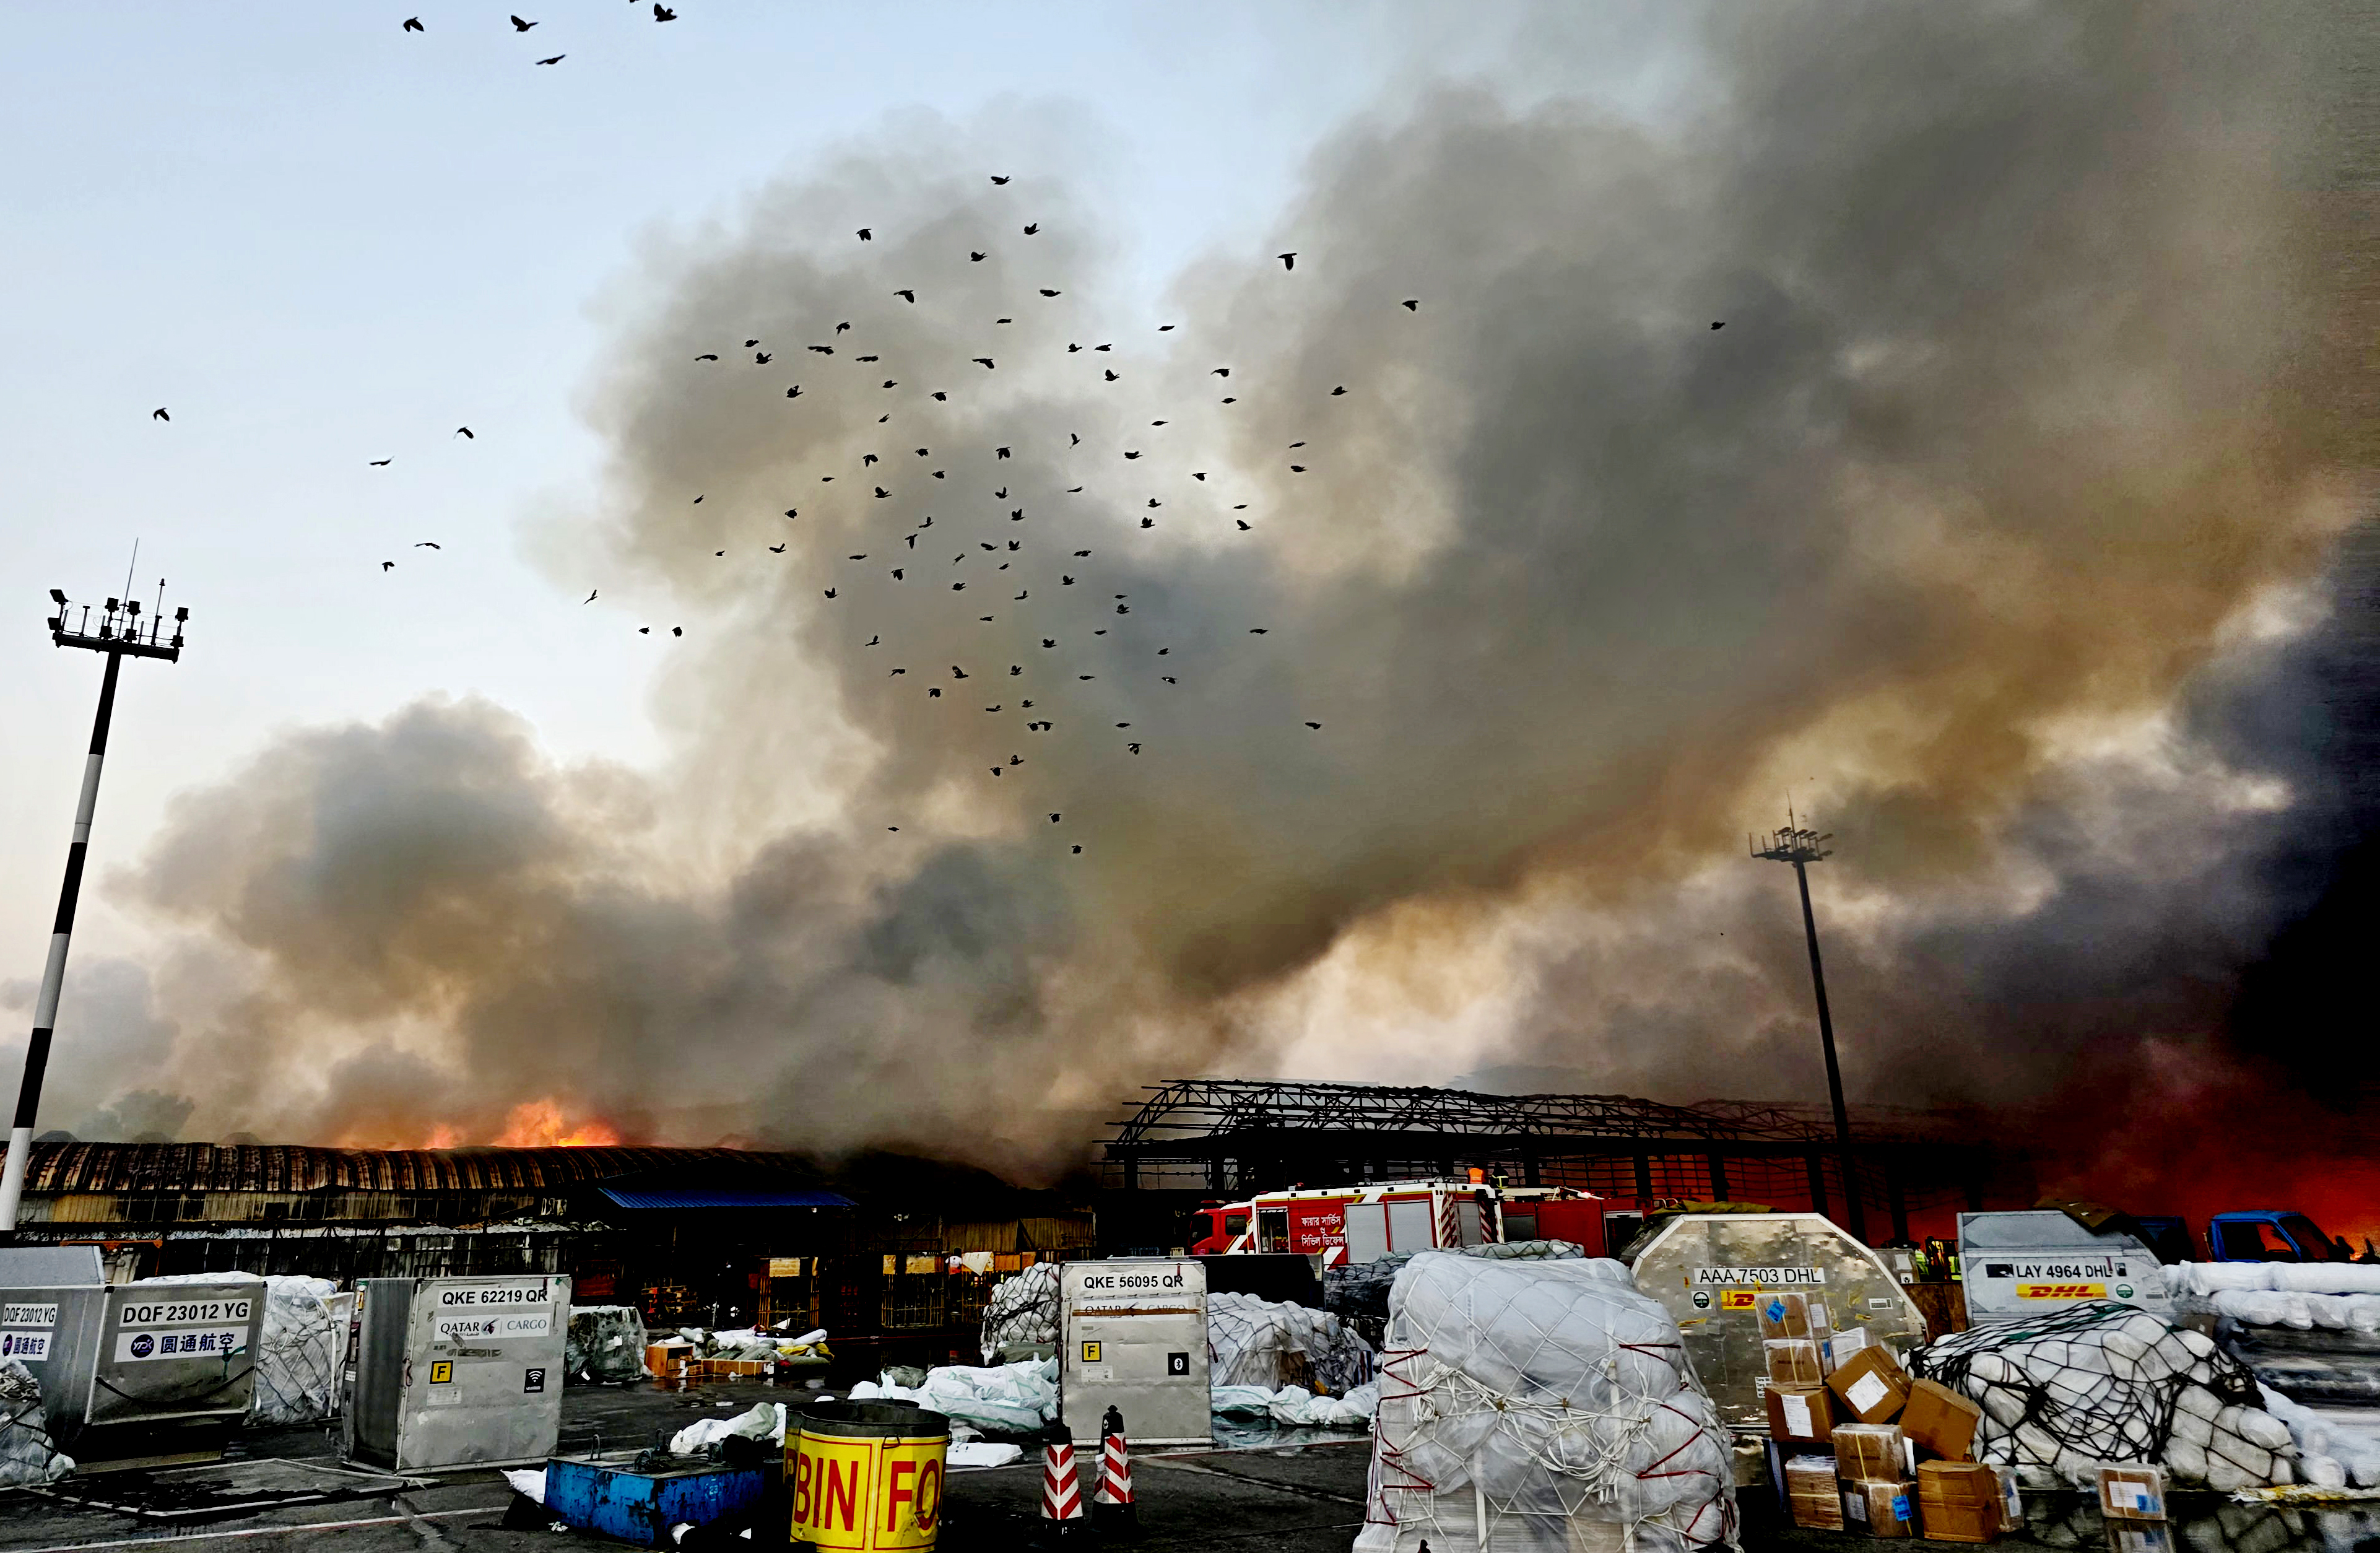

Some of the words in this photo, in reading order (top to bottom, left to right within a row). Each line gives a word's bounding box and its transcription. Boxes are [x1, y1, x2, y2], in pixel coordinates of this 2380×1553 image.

[1301, 1233, 1321, 1246] সিভিল
[1700, 1269, 1735, 1283] AAA
[1739, 1268, 1779, 1283] 7503
[1784, 1268, 1822, 1283] DHL
[2016, 1265, 2041, 1278] LAY
[2046, 1264, 2082, 1277] 4964
[2085, 1264, 2113, 1277] DHL
[1084, 1276, 1114, 1289] QKE
[1119, 1276, 1158, 1289] 56095
[1162, 1275, 1184, 1287] QR
[442, 1291, 476, 1305] QKE
[480, 1290, 523, 1303] 62219
[526, 1289, 548, 1303] QR
[2028, 1285, 2094, 1297] DHL
[4, 1307, 21, 1322] DQF
[20, 1307, 43, 1323] 23012
[44, 1307, 56, 1323] YG
[123, 1305, 163, 1323] DQF
[166, 1303, 219, 1321] 23012
[224, 1302, 248, 1318] YG
[440, 1321, 480, 1334] QATAR
[507, 1319, 547, 1330] CARGO
[160, 1333, 235, 1355] 圆通航空
[1087, 1345, 1096, 1358] F
[436, 1365, 447, 1379] F
[794, 1451, 859, 1531] BIN
[887, 1458, 946, 1532] FO
